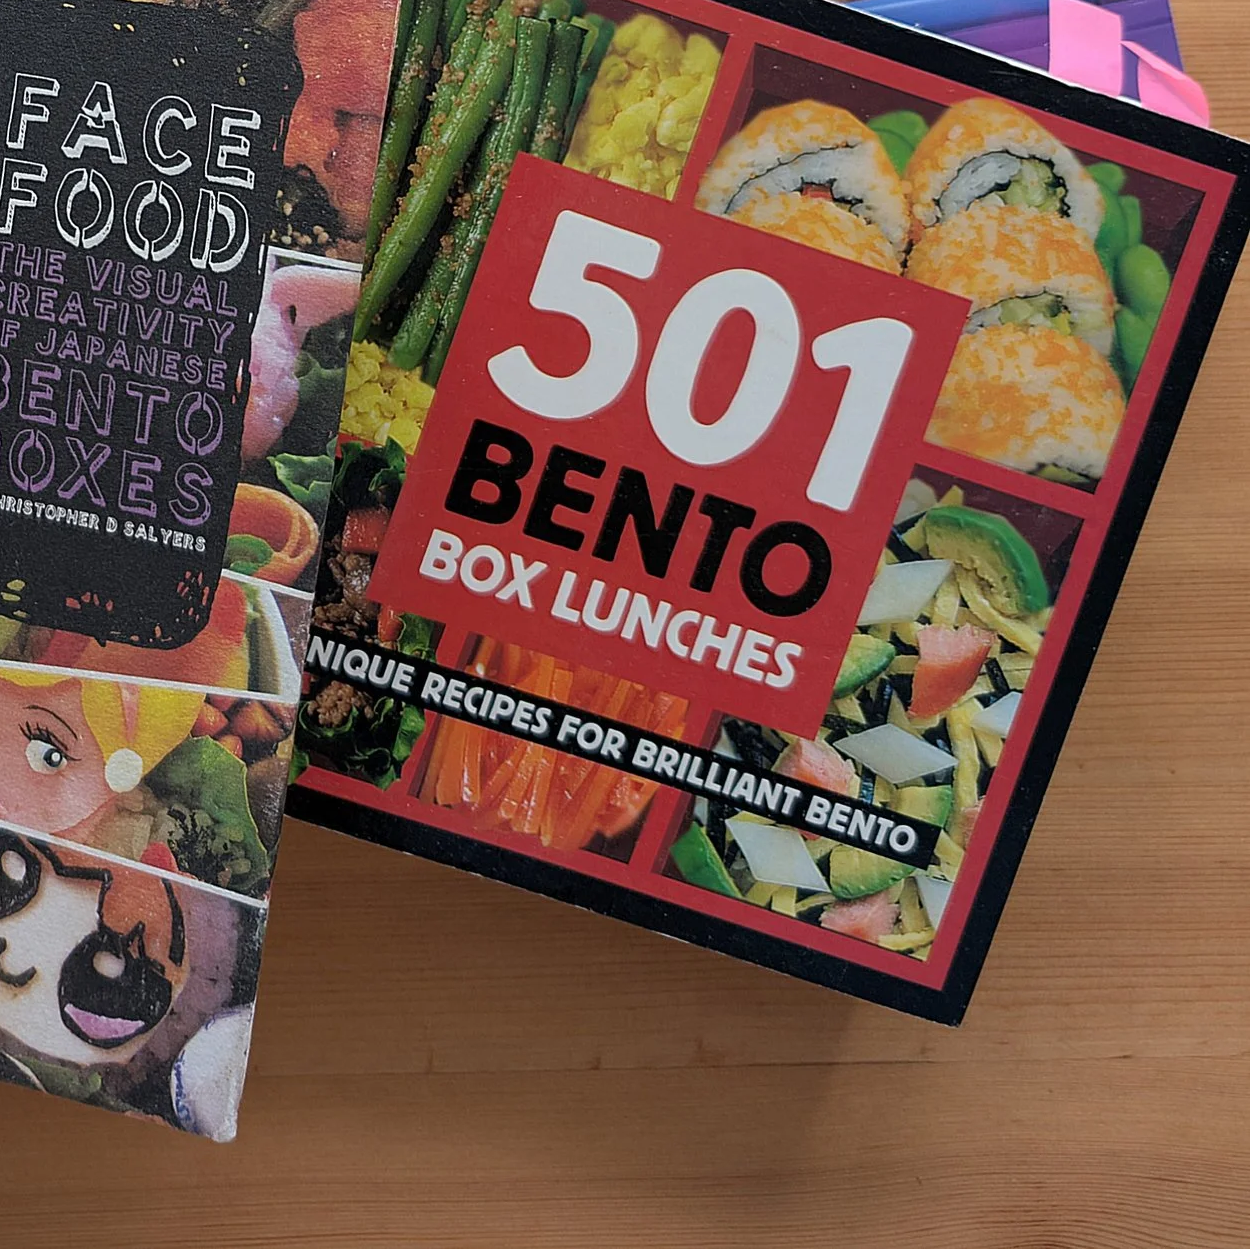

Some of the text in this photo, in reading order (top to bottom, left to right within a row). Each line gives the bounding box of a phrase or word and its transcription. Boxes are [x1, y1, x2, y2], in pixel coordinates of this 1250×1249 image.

[6, 72, 261, 190] FACE
[86, 255, 239, 317] VISUAL
[35, 327, 227, 391] JAPANESE
[486, 208, 914, 513] 501
[106, 517, 118, 533] D
[123, 521, 206, 552] SALYERS
[444, 418, 833, 619] BENTO
[419, 529, 805, 690] BOX LUNCHES
[306, 635, 918, 852] NIQUE RECIPES FOR BRILLIANT BENTO
